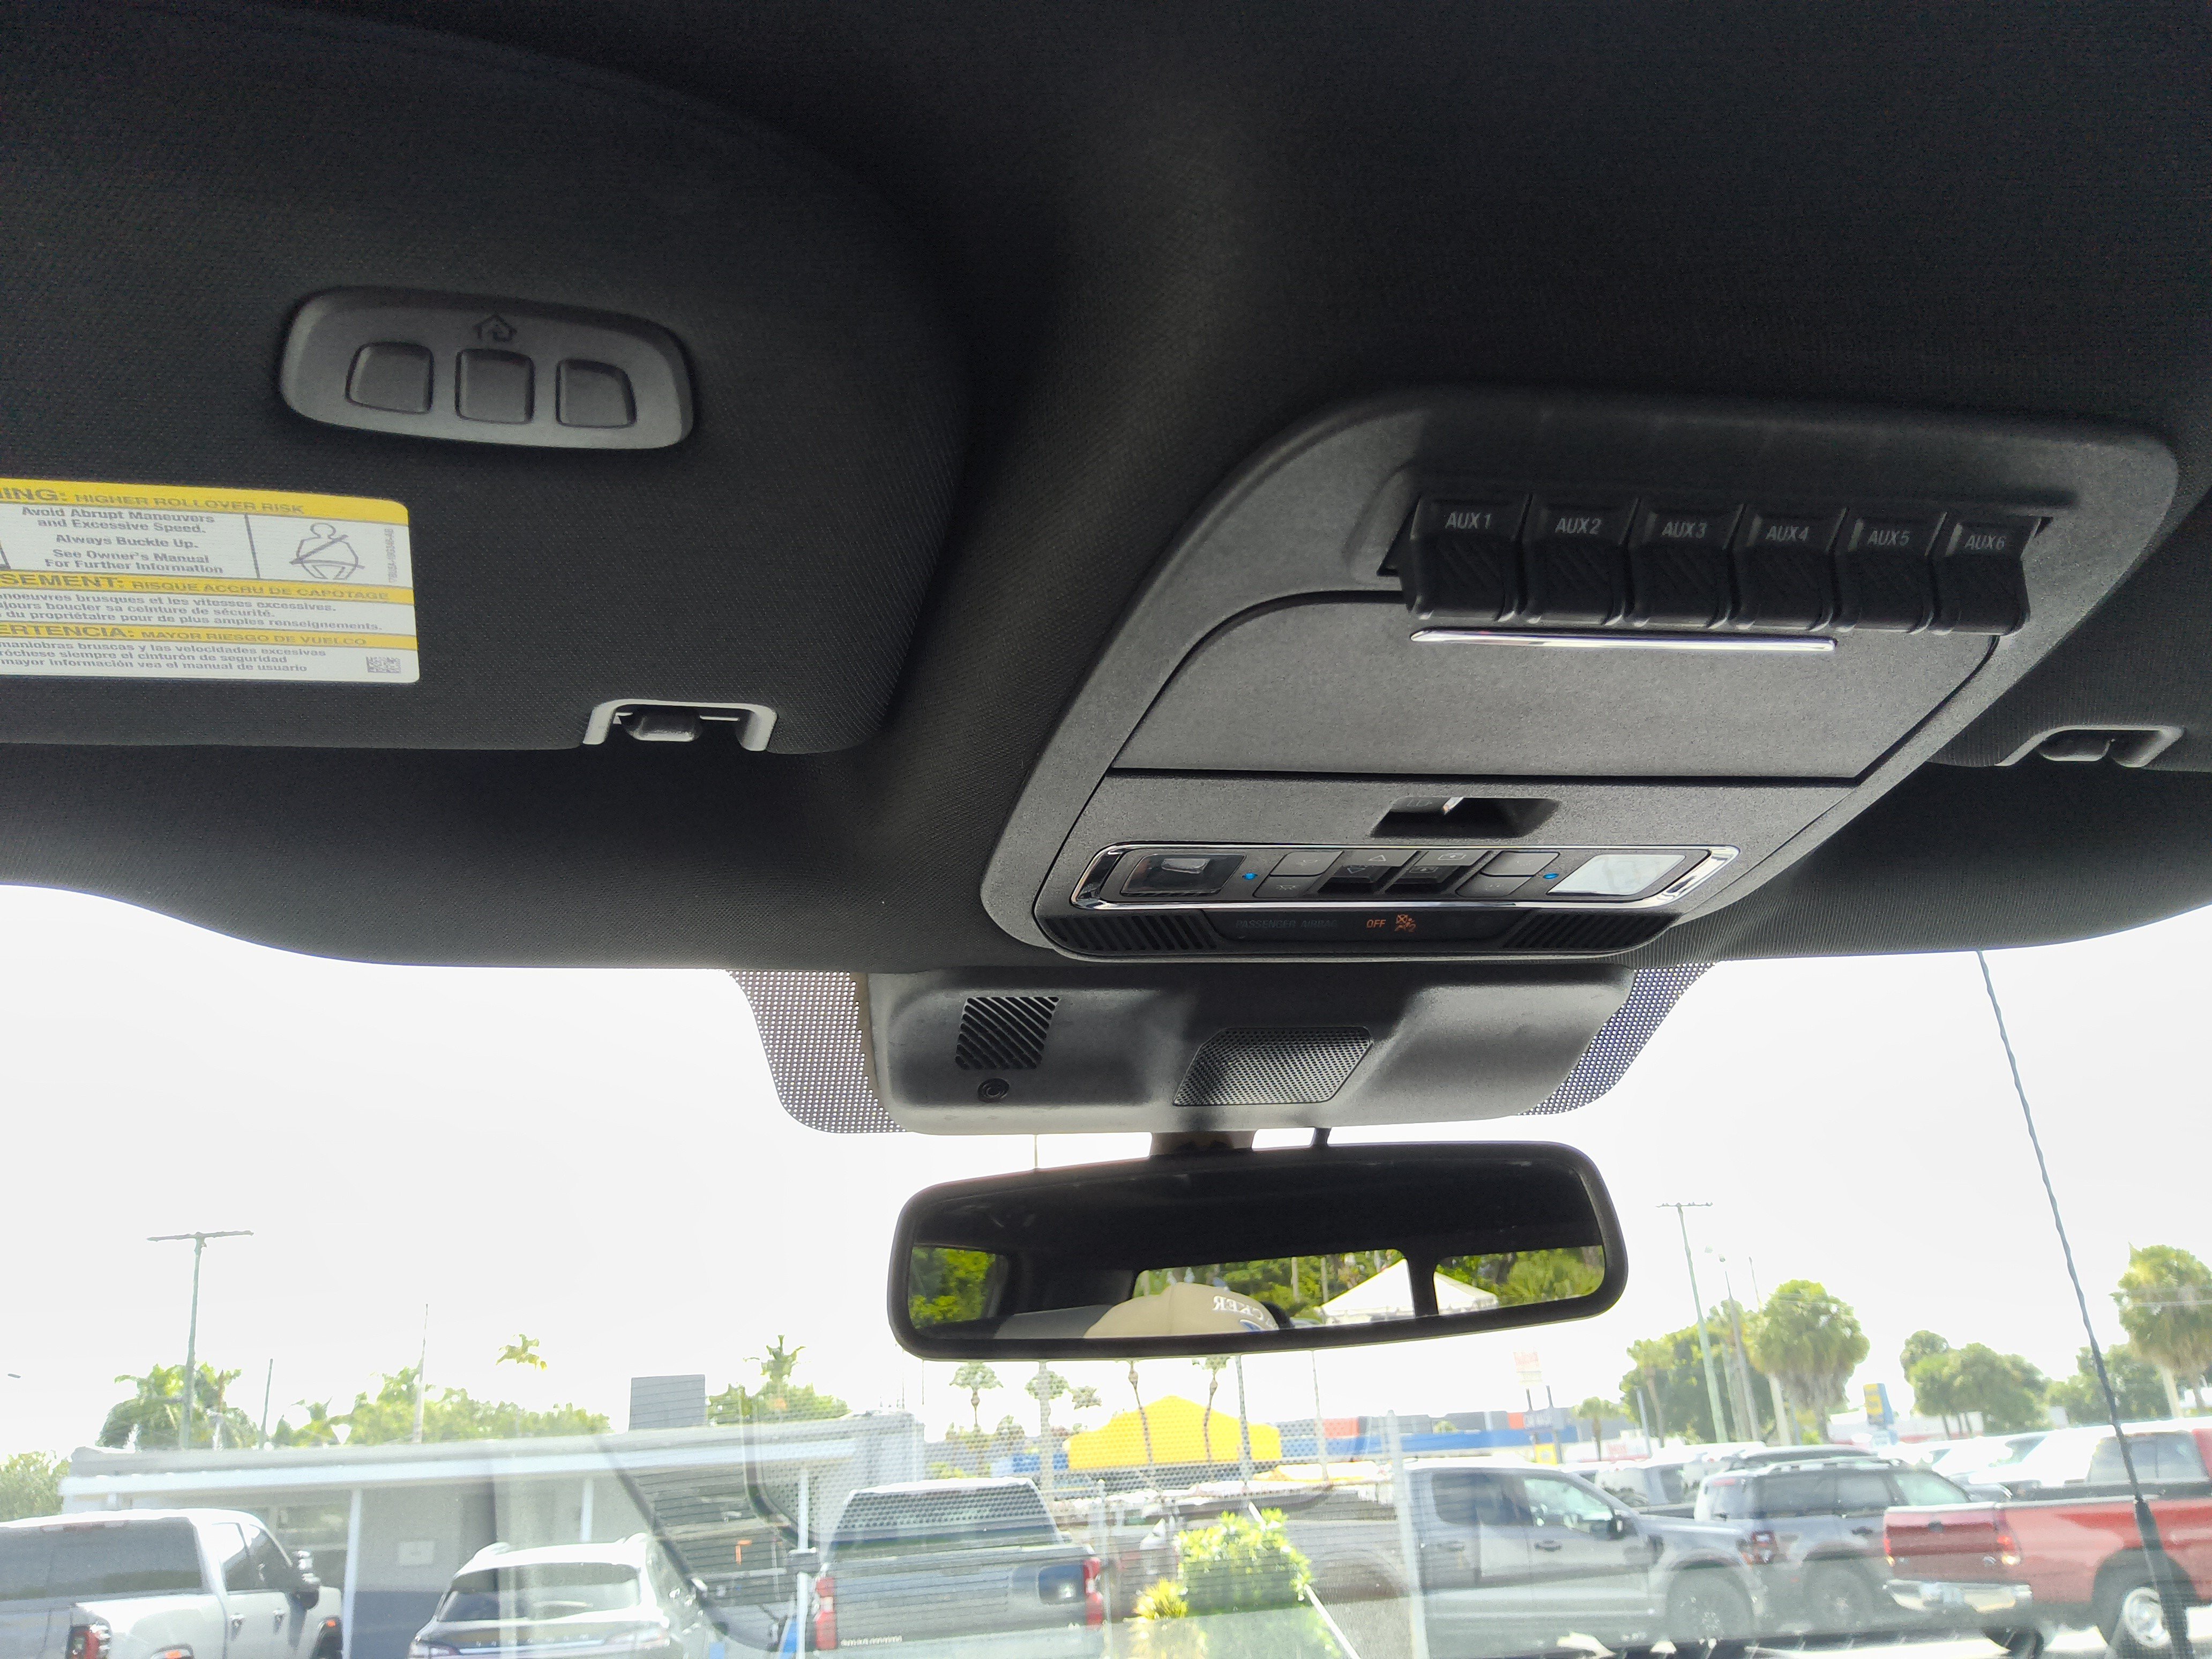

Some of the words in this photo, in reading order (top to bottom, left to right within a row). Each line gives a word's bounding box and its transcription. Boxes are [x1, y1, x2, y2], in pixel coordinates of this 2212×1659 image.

[0, 487, 68, 502] ING:
[74, 494, 148, 505] HIGHER
[261, 502, 305, 514] RISK
[23, 507, 65, 517] Avoid
[71, 509, 124, 519] Abrupt
[129, 511, 214, 523] Maneuvers
[38, 519, 67, 527] and
[72, 519, 148, 530] Excessive
[153, 522, 206, 533] Speed.
[56, 534, 112, 545] Always
[116, 536, 169, 547] Buckle
[173, 538, 199, 549] Up.
[53, 549, 81, 558] See
[86, 550, 150, 561] Owner's
[153, 552, 210, 563] Manual
[45, 559, 70, 568] For
[74, 560, 131, 570] Further
[136, 562, 223, 574] Information
[132, 581, 198, 592] RISQUE
[204, 584, 264, 594] ACCRU
[269, 586, 292, 595] DE
[297, 587, 390, 600] CAPOTAGE
[46, 602, 101, 611] boucler
[128, 604, 188, 614] ceinture
[191, 607, 209, 615] de
[213, 608, 275, 617] sécurité.
[76, 594, 145, 604] brusques
[150, 596, 163, 604] et
[167, 596, 189, 605] les
[193, 599, 252, 608] vitesses
[257, 601, 337, 611] excessives.
[6, 610, 26, 619] du
[29, 611, 116, 621] propriétaire
[121, 614, 154, 622] pour
[180, 616, 210, 624] plus
[214, 617, 265, 626] amples
[269, 619, 383, 631] renseignements.
[141, 631, 202, 640] MAYOR
[206, 633, 269, 642] RIESGO
[274, 635, 295, 643] DE
[300, 636, 367, 645] VUELCO
[78, 642, 134, 651] bruscas
[138, 644, 146, 652] y
[175, 645, 257, 654] velocidades
[261, 648, 326, 656] excesivas
[1, 659, 44, 667] mayor
[48, 659, 133, 668] información
[59, 651, 117, 660] siempre
[137, 653, 196, 661] cinturón
[220, 655, 287, 663] seguridad
[1235, 919, 1296, 929] PASSENGER
[1366, 918, 1387, 929] OFF
